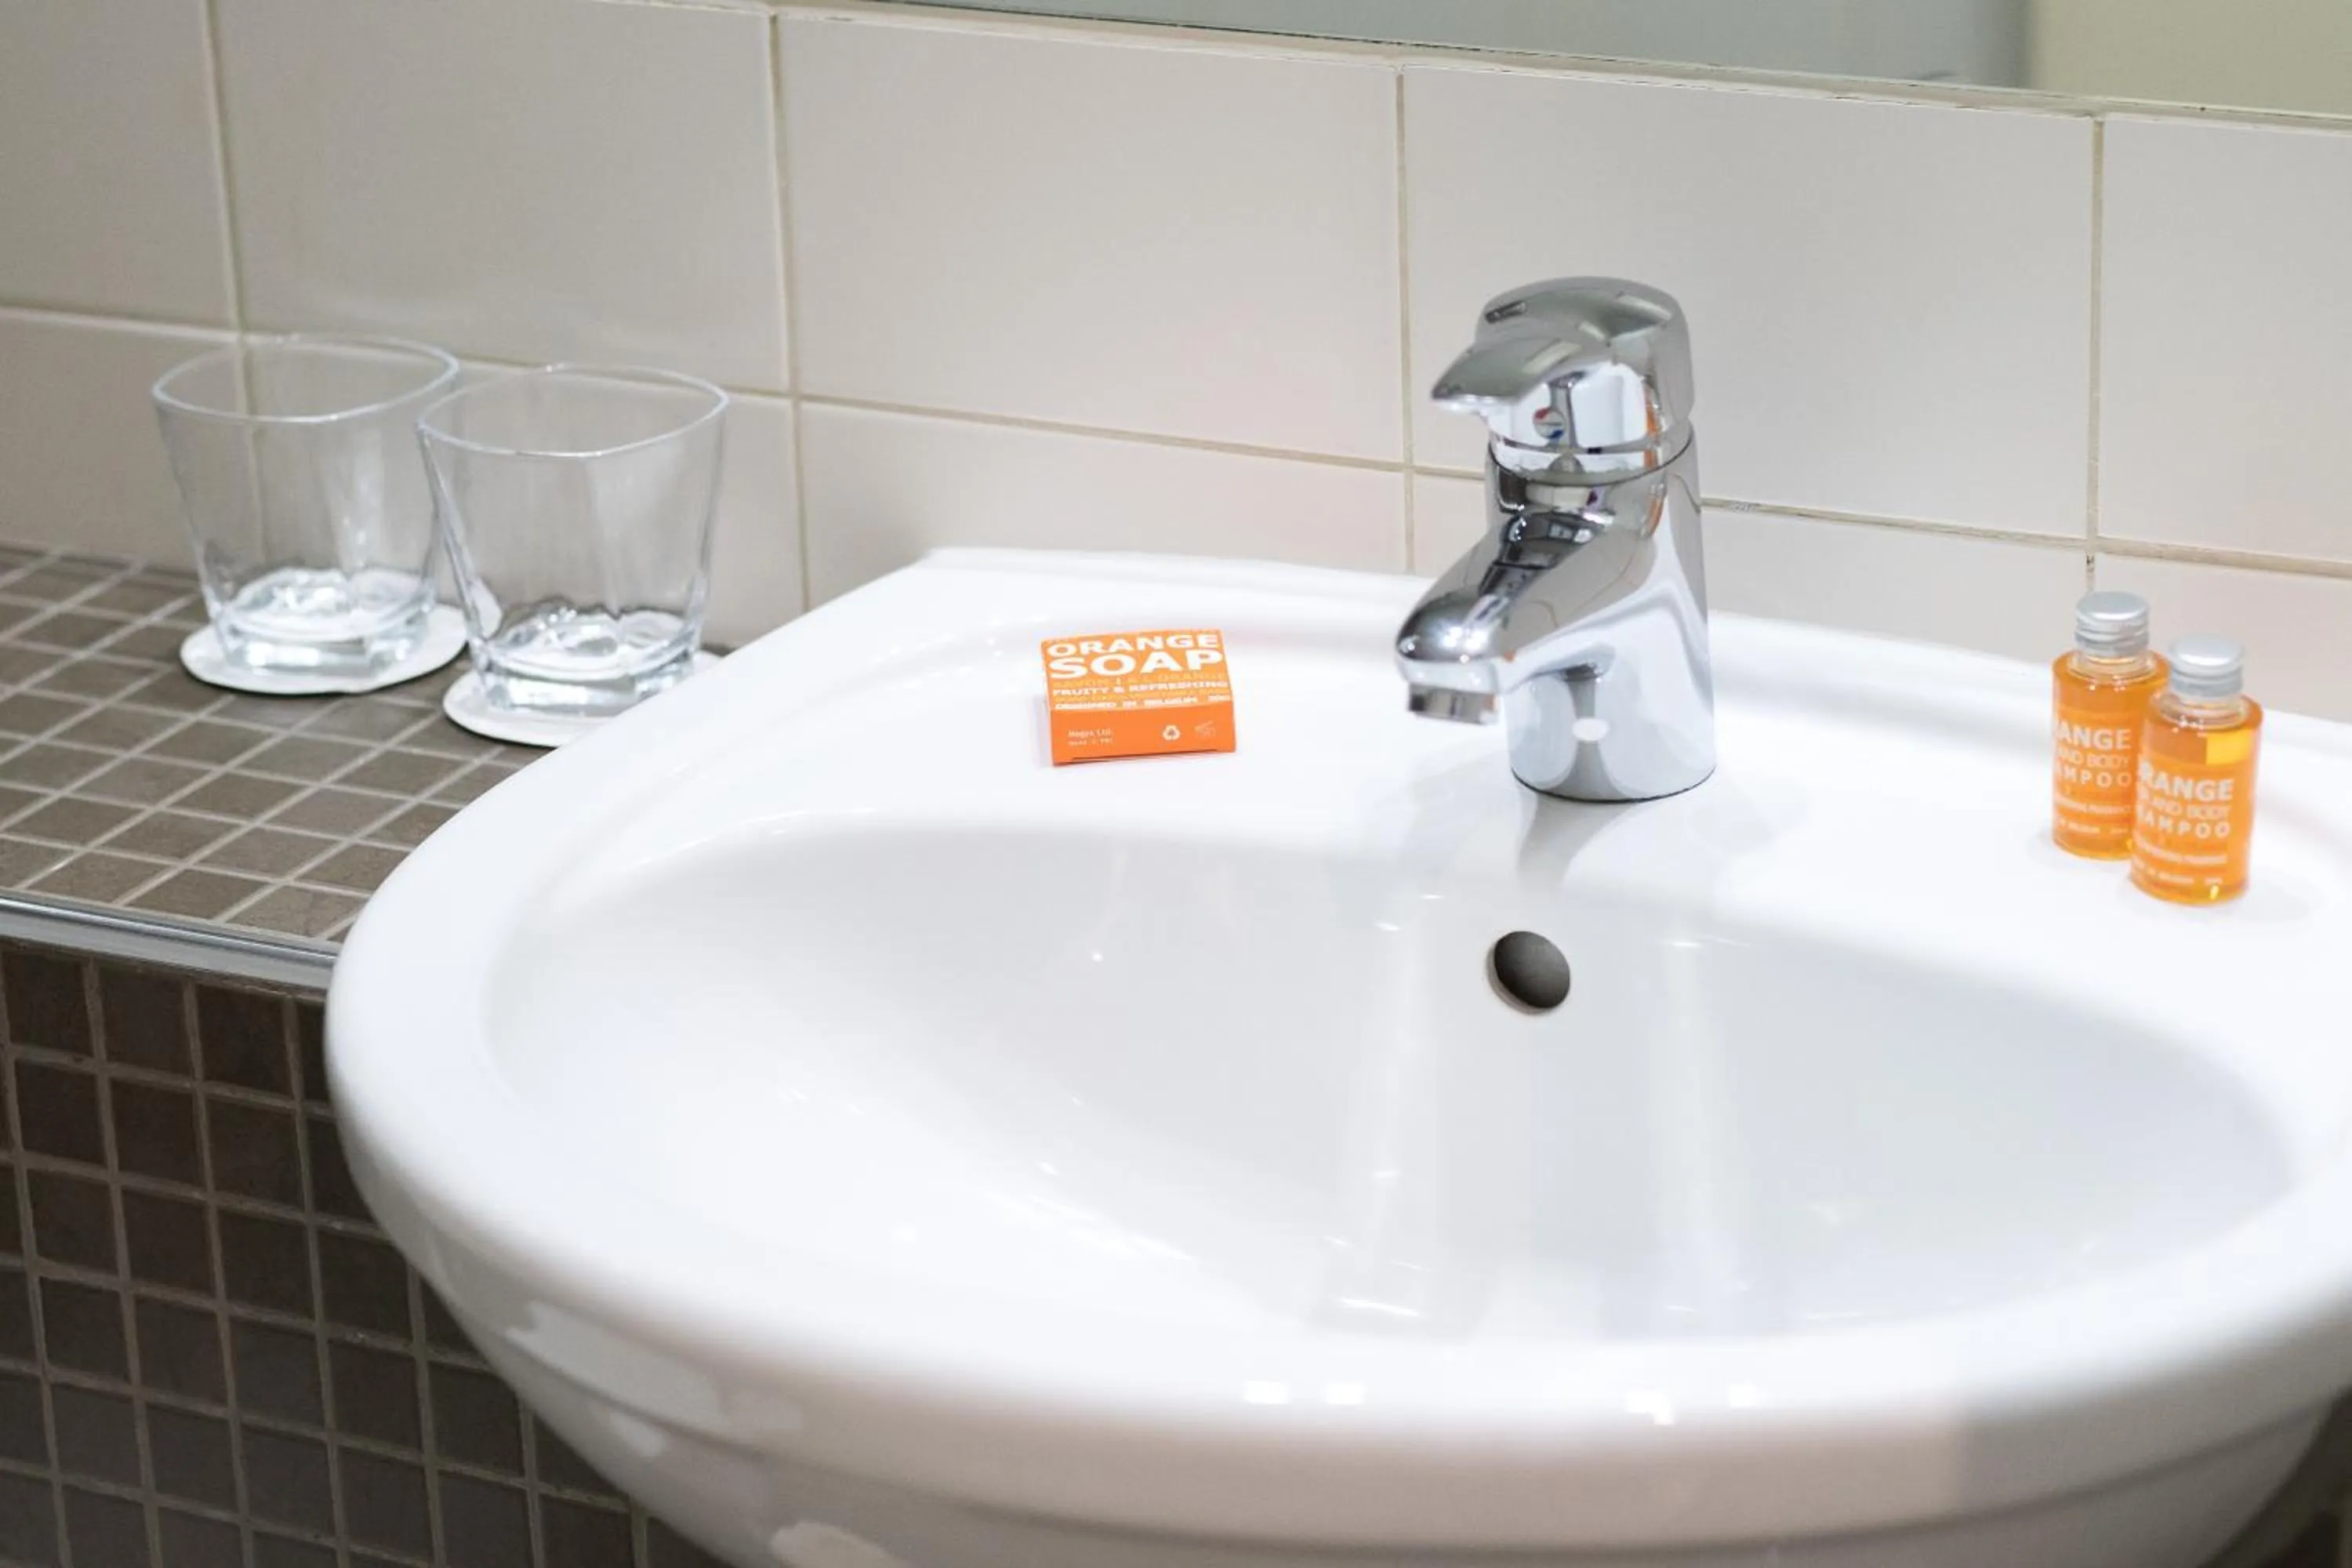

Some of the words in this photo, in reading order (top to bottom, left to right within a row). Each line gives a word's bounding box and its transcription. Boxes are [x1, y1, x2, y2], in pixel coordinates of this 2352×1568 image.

[1048, 634, 1218, 656] ORANGE
[1049, 648, 1224, 679] SOAP
[1054, 688, 1109, 696] FRUITY
[1129, 681, 1229, 693] REFRESHING
[2055, 717, 2132, 751] ANGE
[2055, 762, 2132, 788] AMPOO
[2138, 757, 2234, 801] RANGE
[2138, 802, 2230, 839] AMPOO
